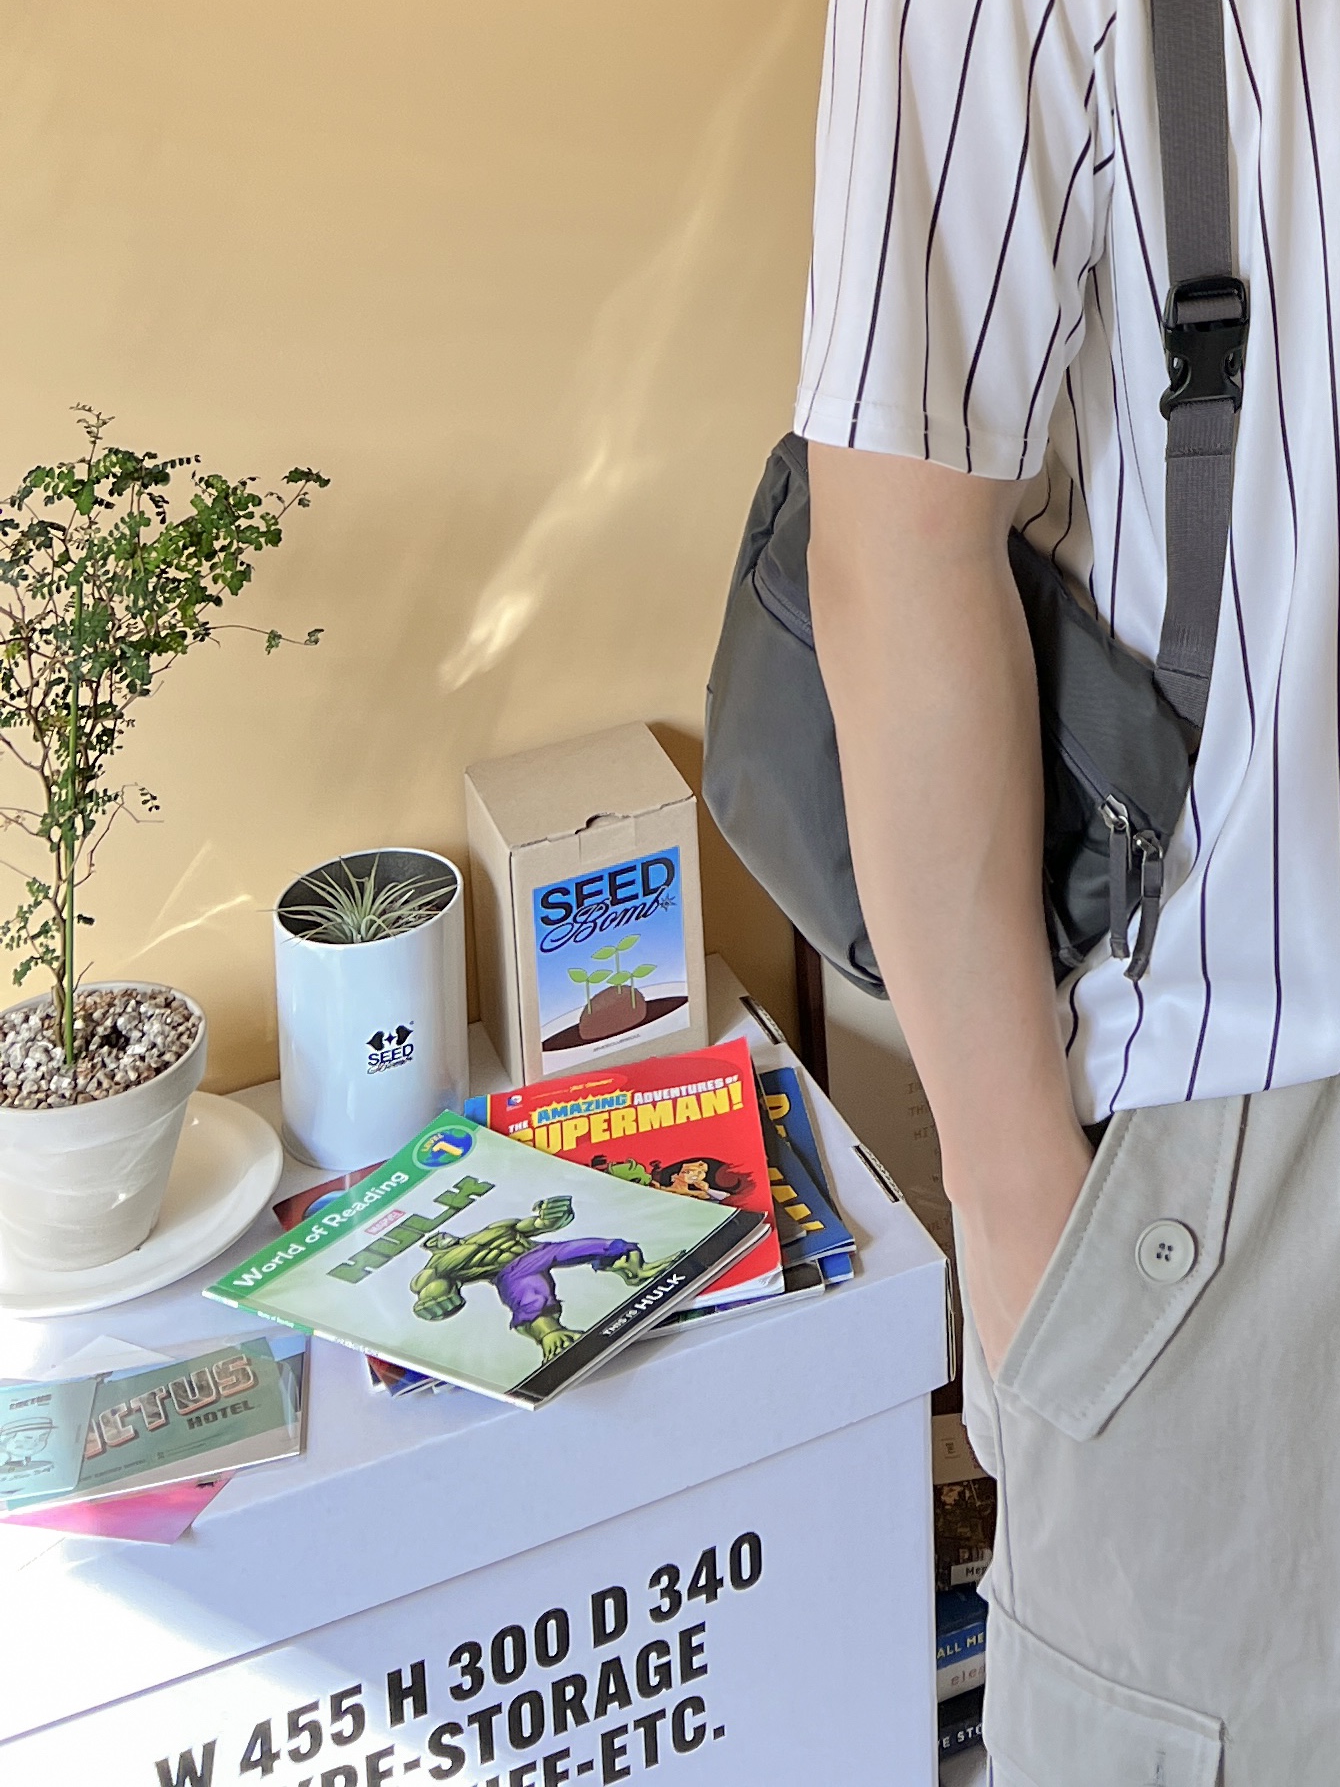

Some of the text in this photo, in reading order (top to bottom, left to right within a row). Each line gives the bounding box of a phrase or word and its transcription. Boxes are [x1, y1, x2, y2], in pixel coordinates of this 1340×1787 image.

[539, 886, 668, 953] Bomb
[540, 857, 675, 926] SEED
[368, 1043, 414, 1066] SEED
[508, 1120, 529, 1133] THE
[537, 1094, 627, 1124] AMAZING
[433, 1141, 462, 1156] 1
[233, 1171, 409, 1288] World of Reading
[327, 1175, 496, 1284] HULK
[603, 1318, 627, 1336] THIS
[634, 1274, 686, 1310] HULK
[187, 1400, 256, 1430] HOTEL
[154, 1530, 763, 1787] W 455 H 300 D 340
[966, 1632, 984, 1648] ME
[298, 1621, 708, 1787] E-STORAGE
[937, 1735, 951, 1749] E
